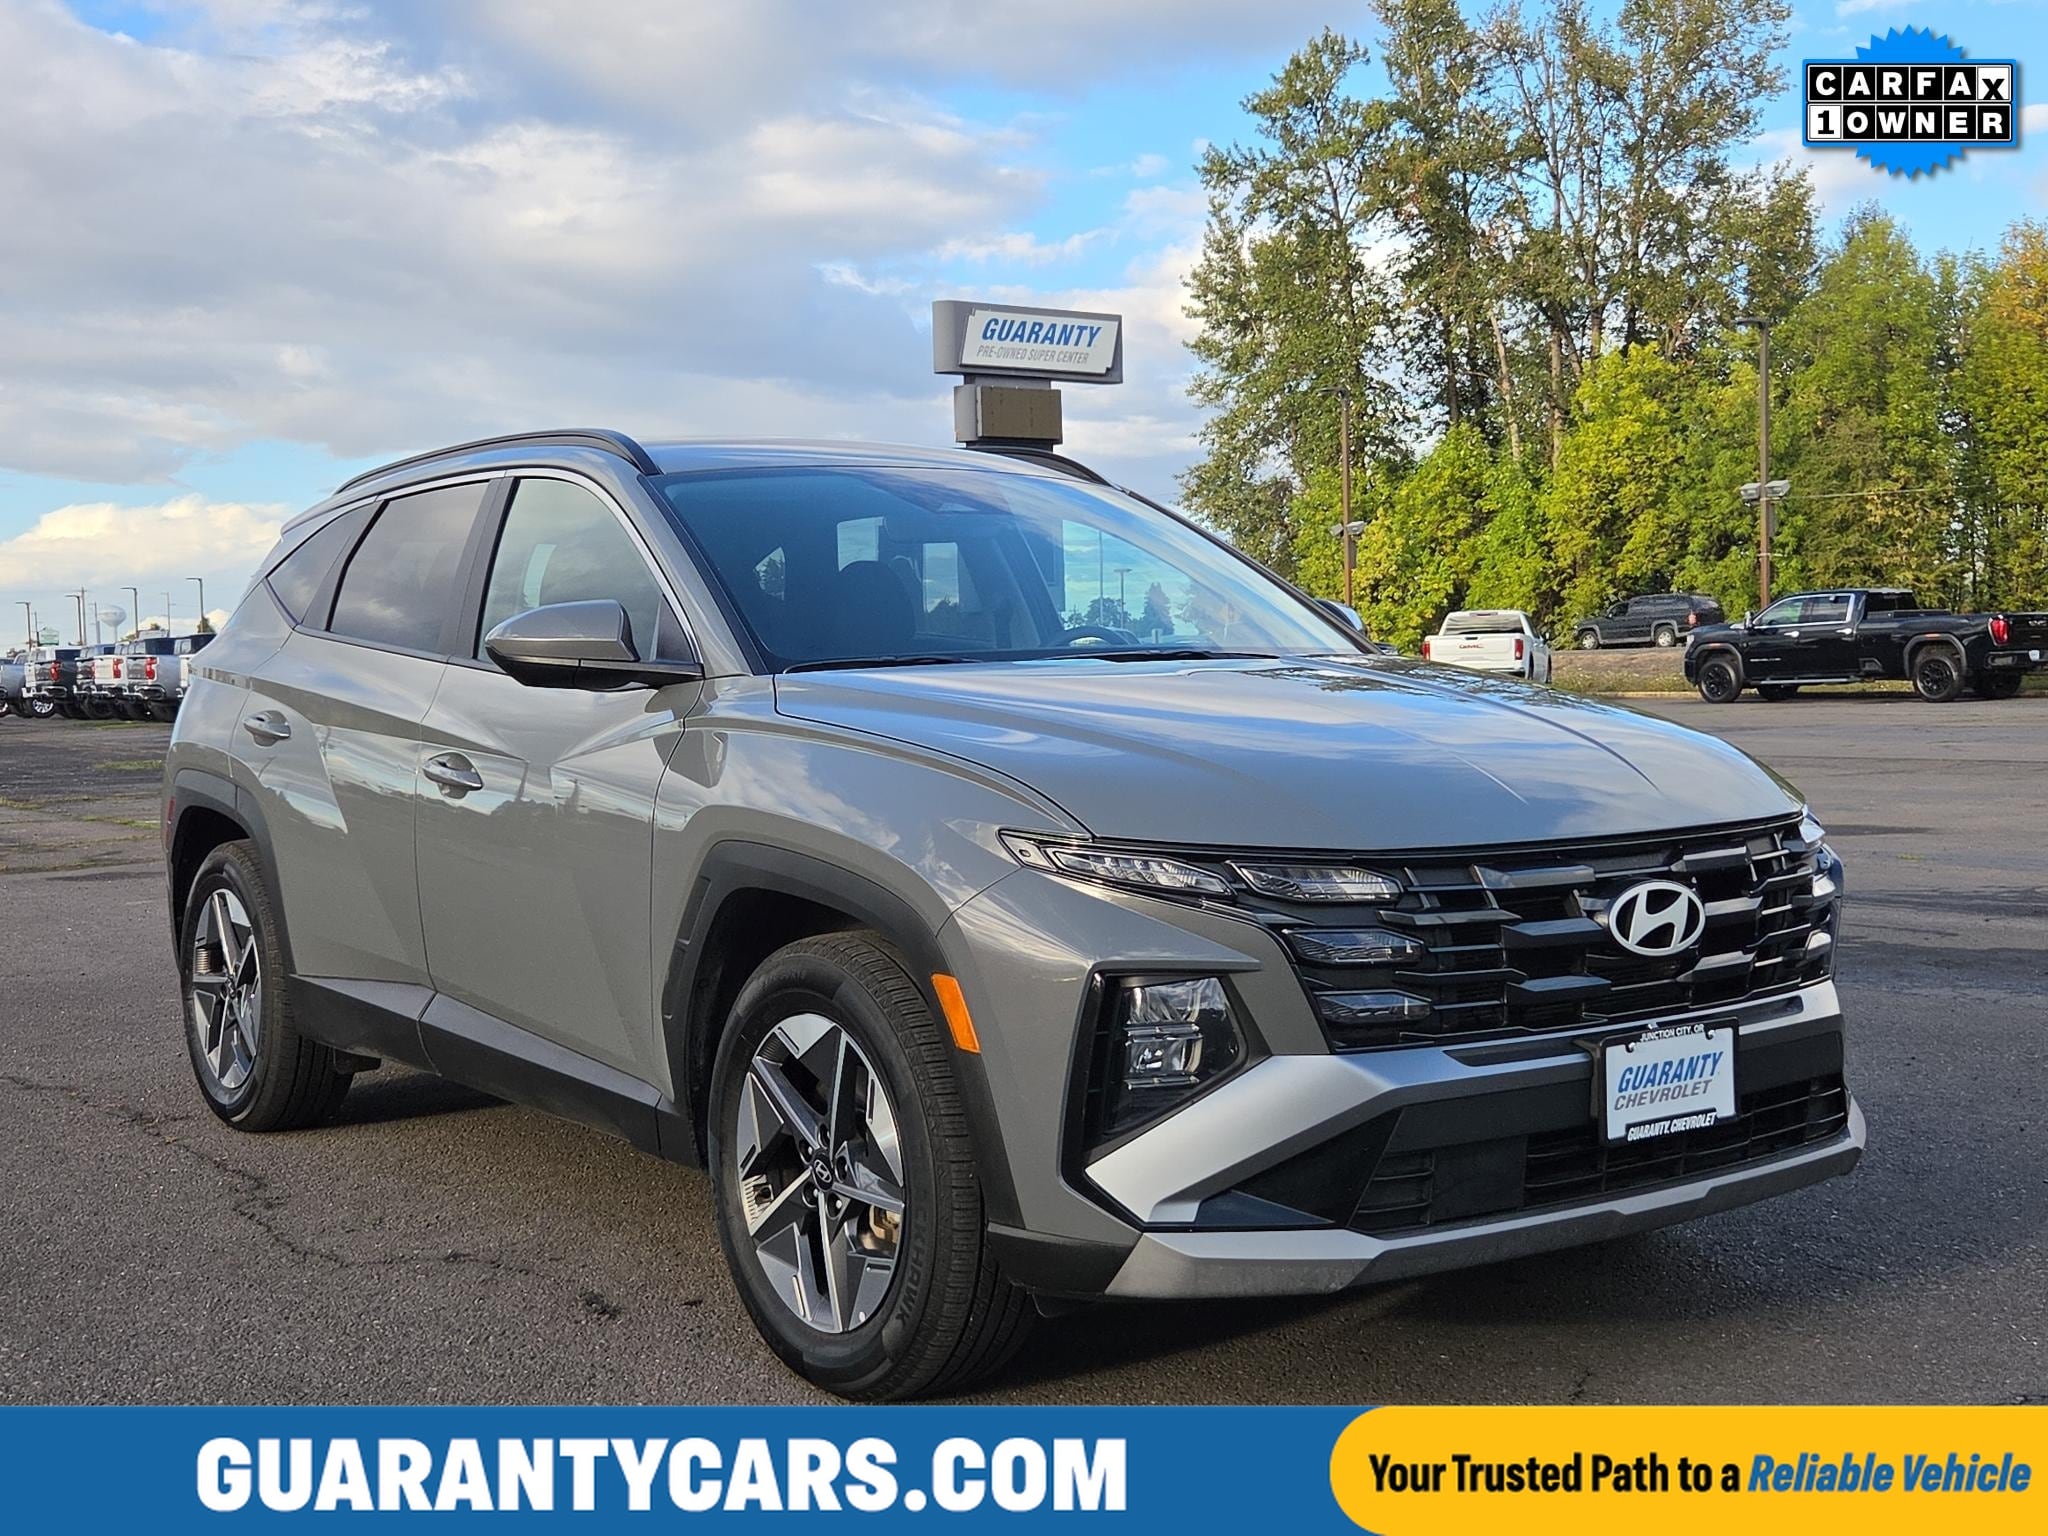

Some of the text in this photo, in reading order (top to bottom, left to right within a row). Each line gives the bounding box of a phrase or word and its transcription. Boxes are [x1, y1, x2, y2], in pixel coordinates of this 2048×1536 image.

[982, 318, 1102, 348] GUARANTY
[977, 345, 1089, 364] PRE-OWNED SUPER CENTER
[1618, 1051, 1723, 1093] GUARANTY
[1614, 1079, 1712, 1111] CHEVROLET
[1670, 1112, 1717, 1133] CHEVROLET
